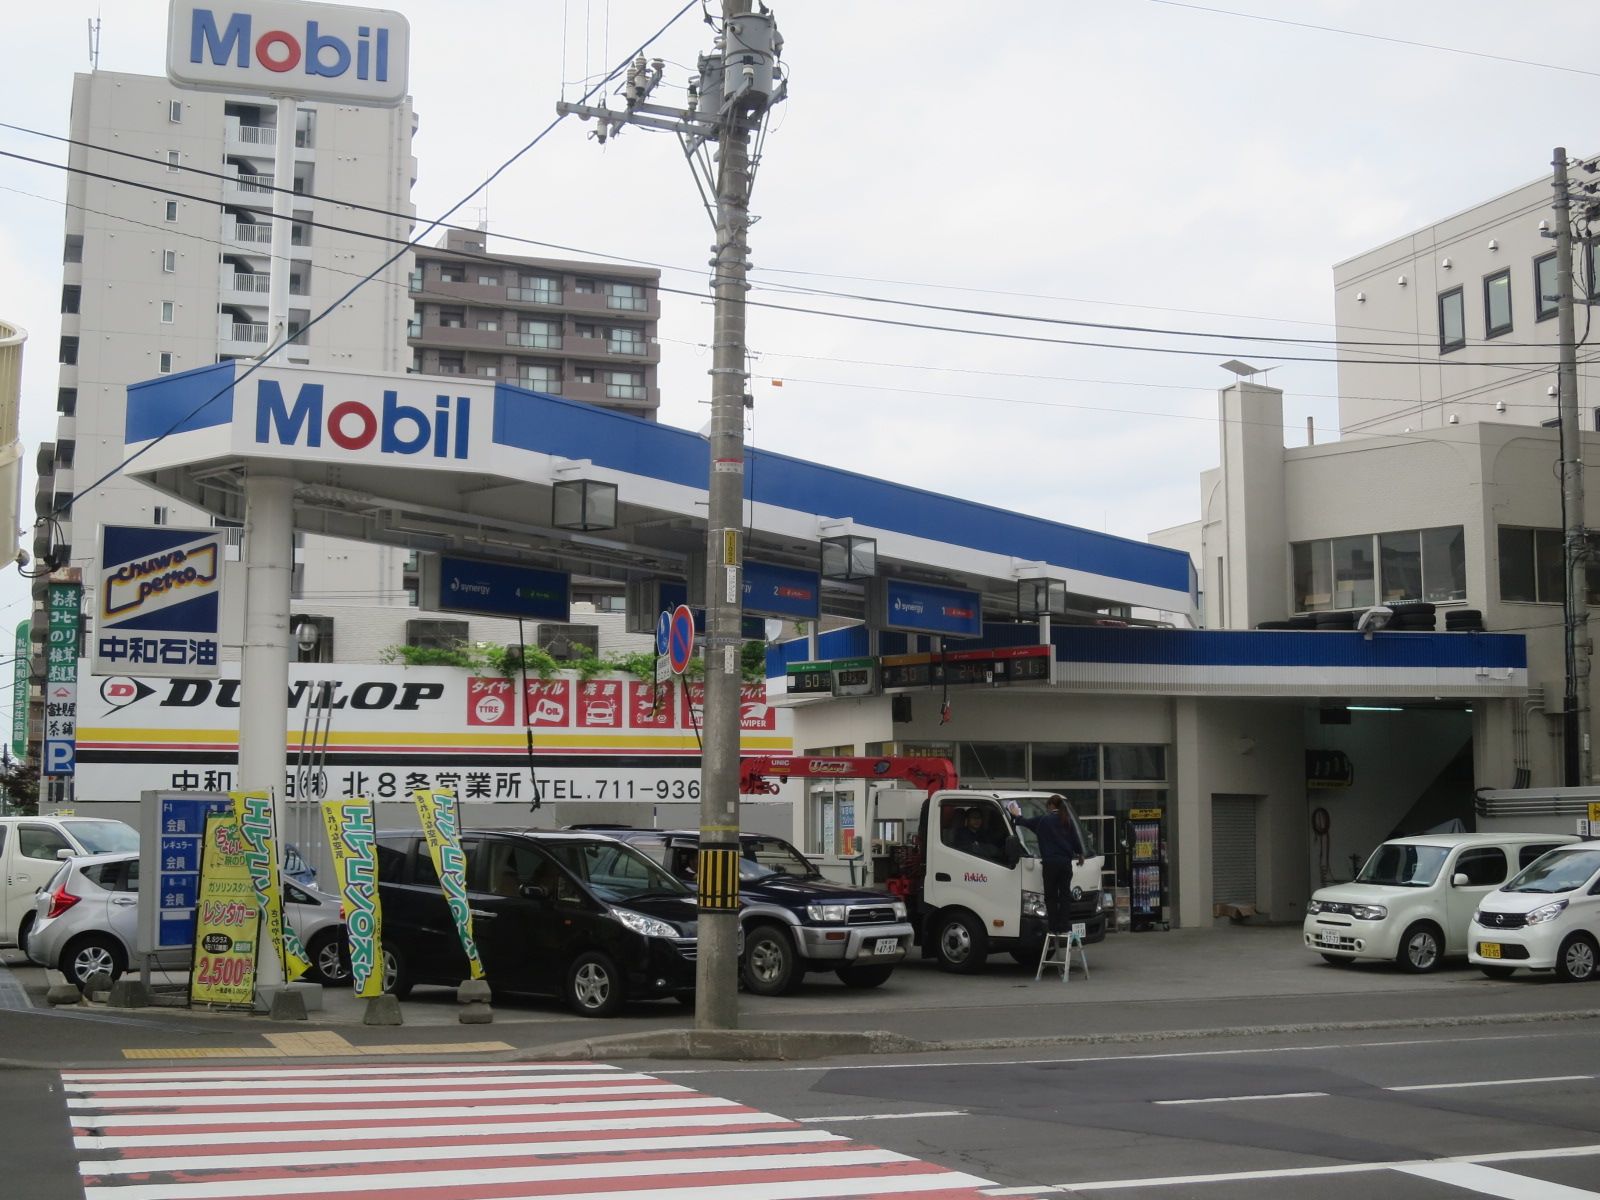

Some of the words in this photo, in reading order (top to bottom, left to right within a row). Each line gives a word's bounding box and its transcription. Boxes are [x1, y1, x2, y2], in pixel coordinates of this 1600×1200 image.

[190, 8, 389, 82] Mobil
[255, 379, 471, 460] Mobil
[117, 550, 186, 580] chuwa
[460, 582, 491, 596] synergy
[772, 585, 779, 596] 2
[51, 589, 78, 608] お茶
[50, 610, 78, 624] コーヒー
[50, 628, 76, 644] のり
[98, 635, 218, 666] 中和石油
[471, 680, 511, 694] タイヤ
[527, 681, 565, 696] オイル
[582, 681, 620, 697] 洗車
[545, 707, 560, 715] OIL
[740, 719, 767, 728] WIPER
[47, 742, 74, 772] P
[342, 771, 522, 800] 北8条営業所
[166, 819, 187, 833] 会員
[162, 840, 193, 850] レギュラー
[165, 856, 186, 870] 会員
[164, 893, 186, 906] 会員
[202, 900, 258, 926] レンタカー
